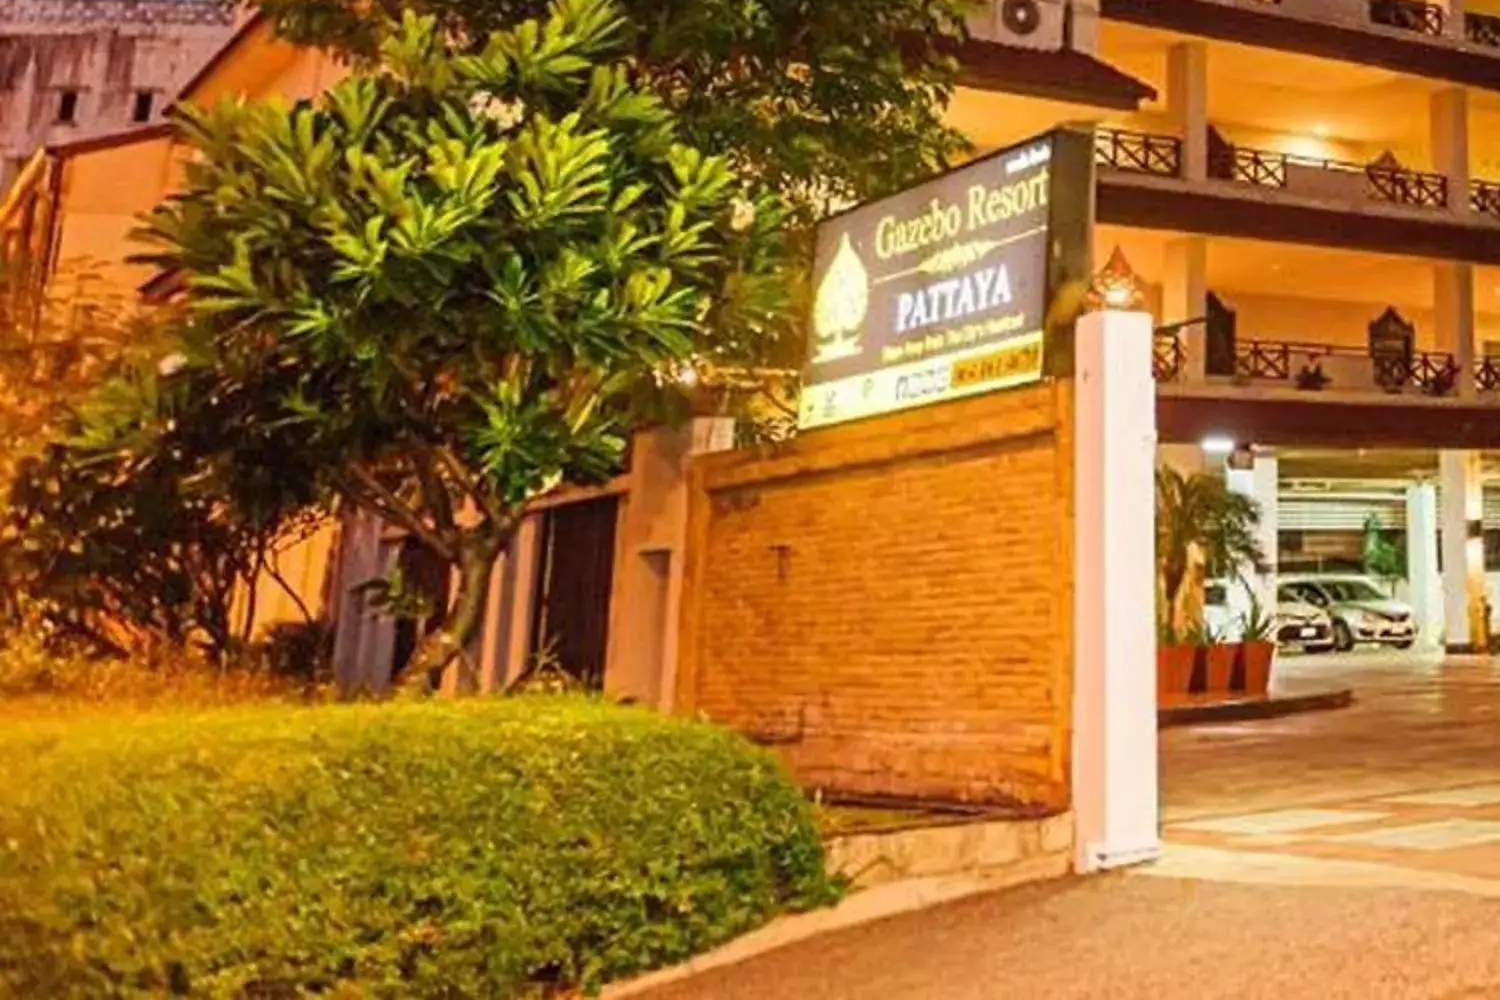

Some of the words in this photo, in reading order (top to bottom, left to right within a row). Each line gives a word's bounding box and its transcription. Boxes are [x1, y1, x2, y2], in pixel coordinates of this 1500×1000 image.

[876, 199, 960, 257] Gazebo
[969, 169, 1048, 225] Resort
[896, 264, 1011, 332] PATTAYA
